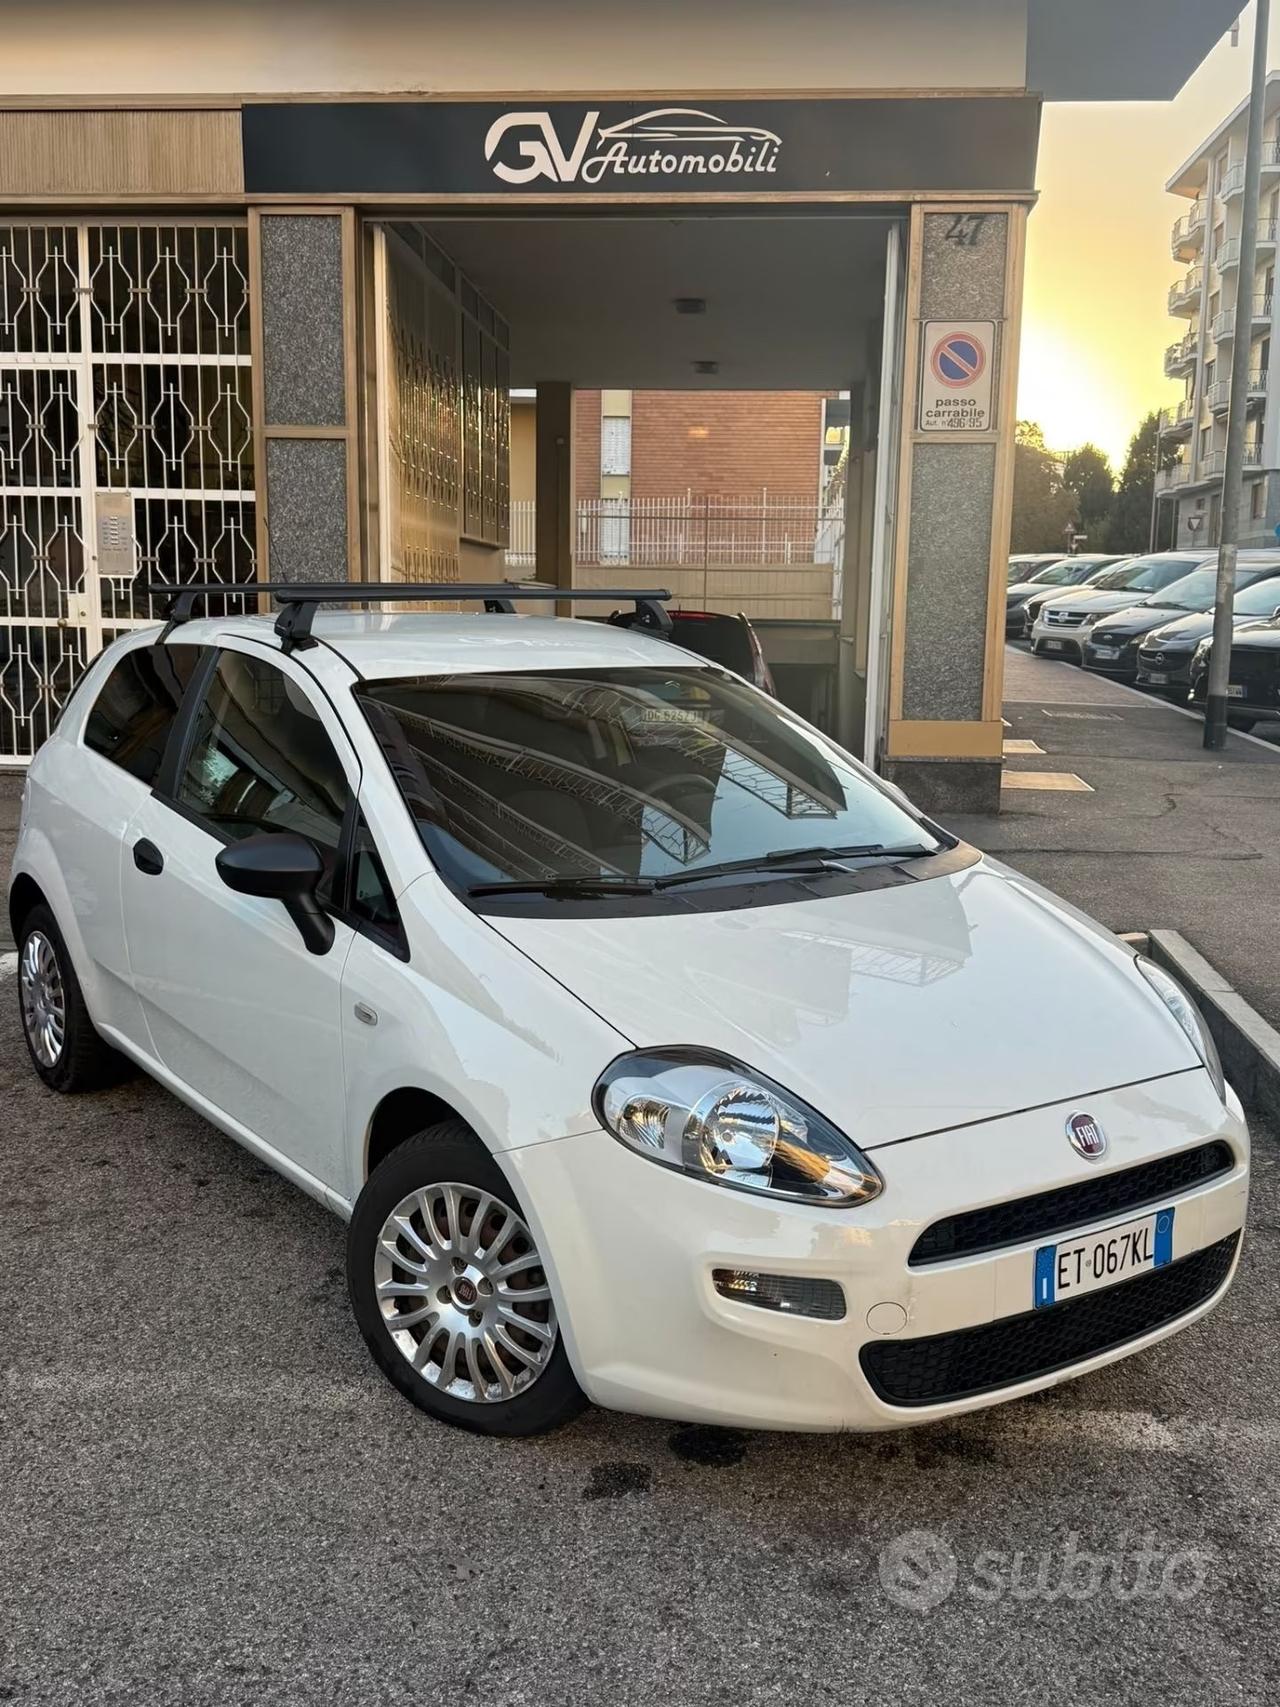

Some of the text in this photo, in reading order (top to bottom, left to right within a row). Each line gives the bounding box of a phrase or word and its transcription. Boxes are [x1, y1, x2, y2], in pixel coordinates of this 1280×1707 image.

[484, 111, 779, 184] GV Automobili
[945, 214, 986, 246] 47
[925, 408, 985, 418] carrabile
[935, 399, 976, 408] passo
[1075, 1123, 1100, 1147] FIAT
